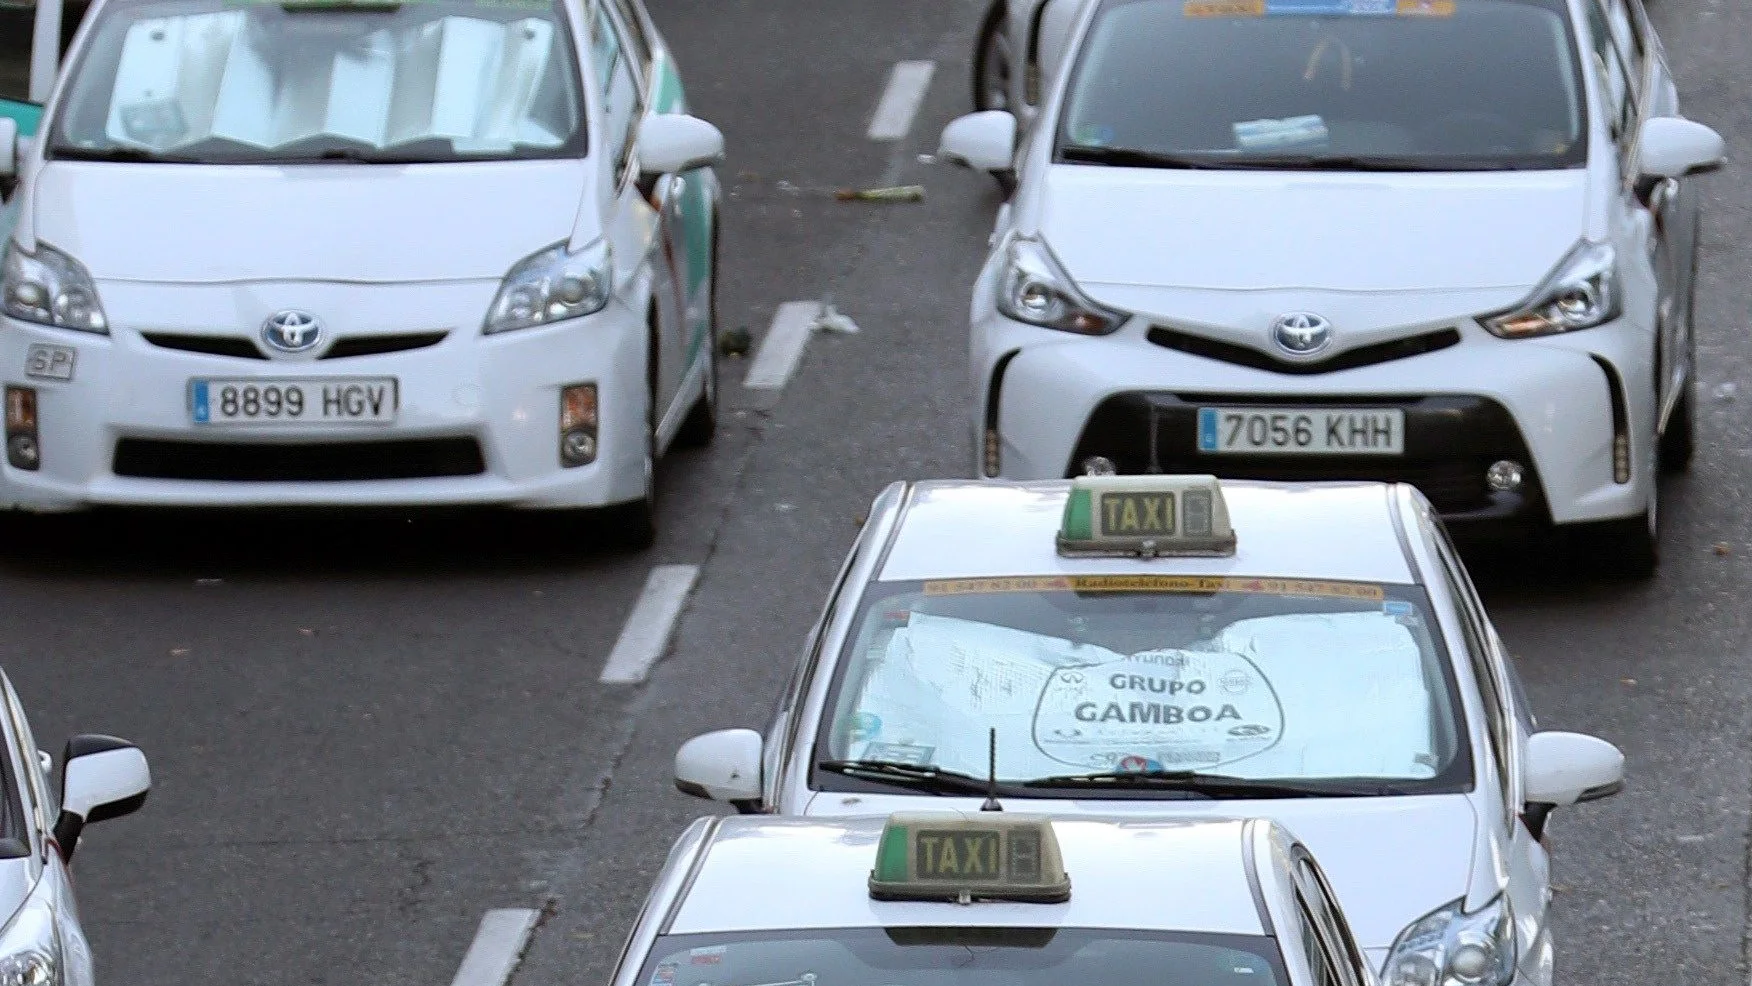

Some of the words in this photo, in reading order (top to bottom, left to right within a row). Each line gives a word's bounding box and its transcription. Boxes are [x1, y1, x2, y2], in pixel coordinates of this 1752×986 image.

[32, 349, 68, 372] SP
[219, 385, 304, 417] 8899
[321, 385, 385, 417] HGV
[1224, 414, 1313, 447] 7056
[1326, 414, 1392, 447] KHH
[1103, 497, 1174, 532] TAXI
[1109, 672, 1206, 696] GRUPO
[1074, 700, 1243, 724] GAMBOA
[920, 836, 999, 875] TAXI
